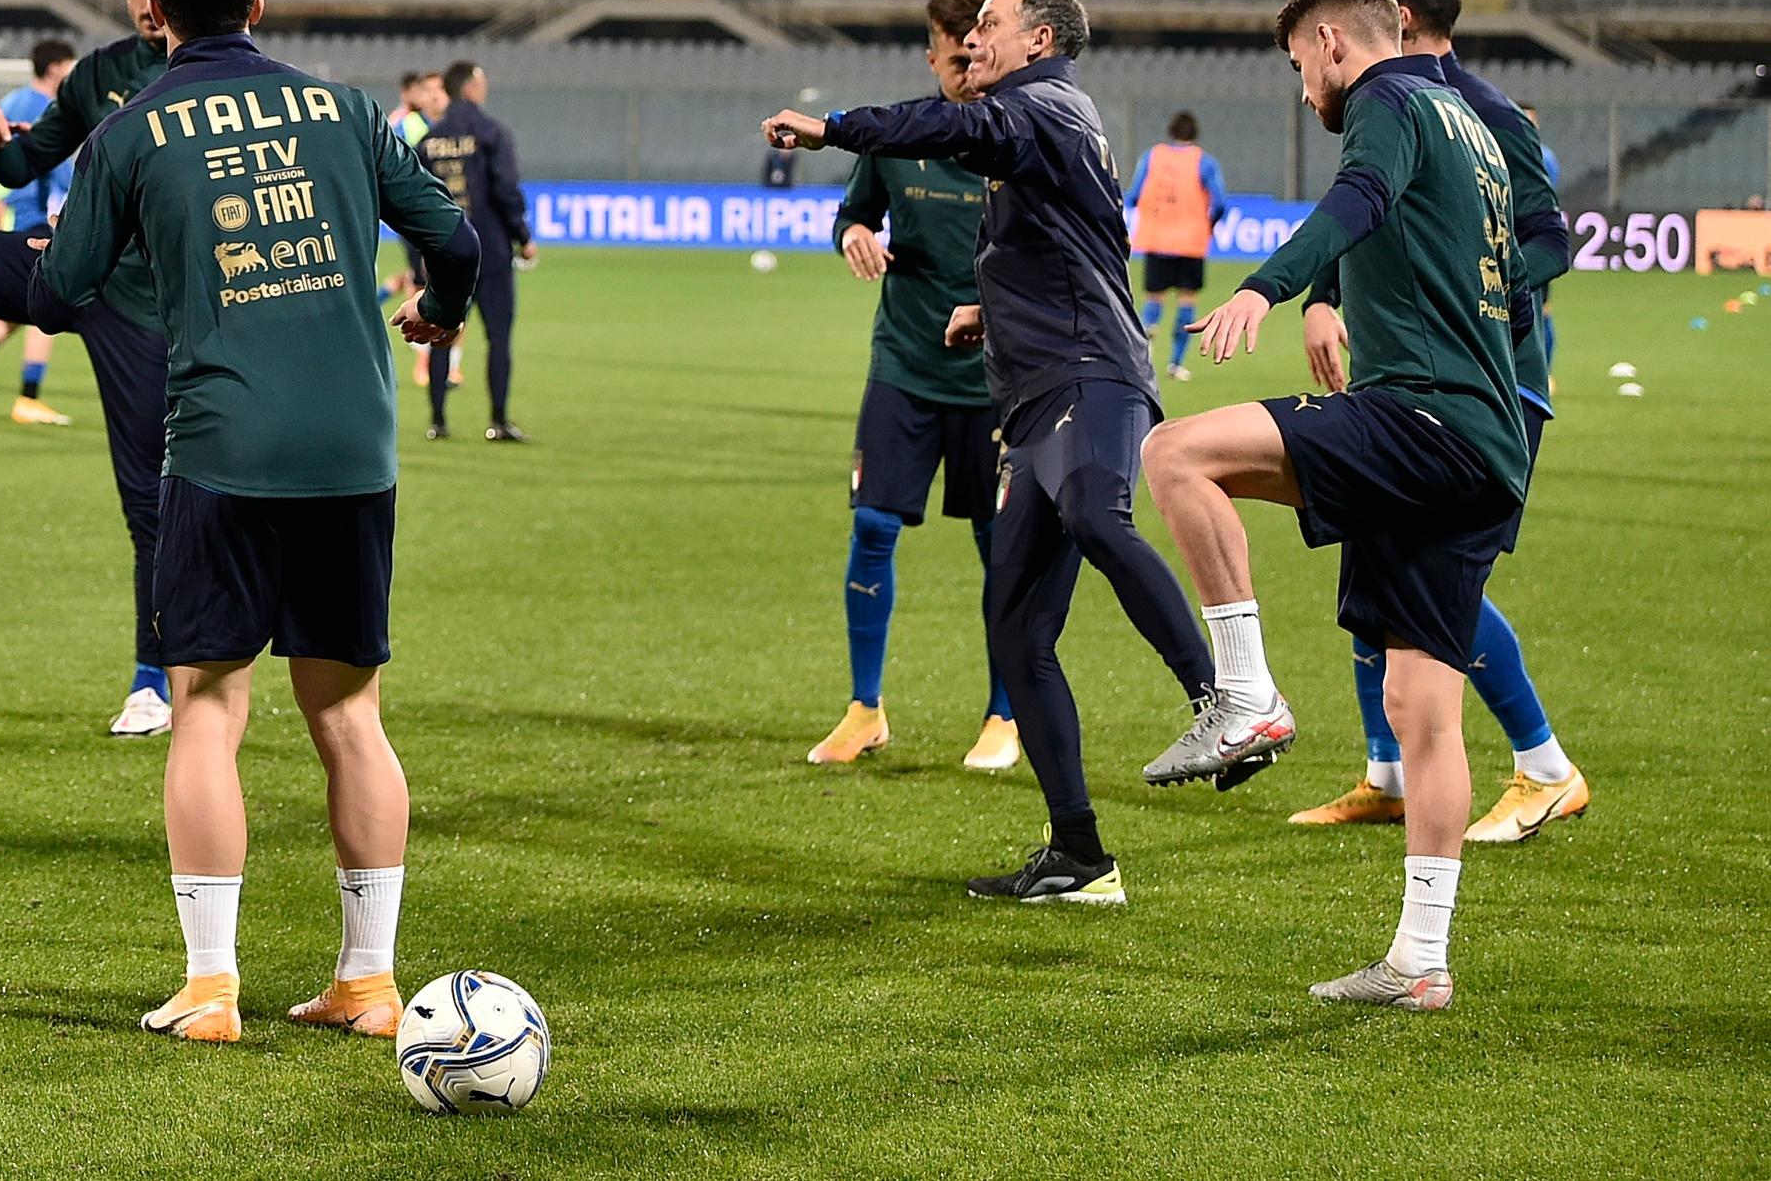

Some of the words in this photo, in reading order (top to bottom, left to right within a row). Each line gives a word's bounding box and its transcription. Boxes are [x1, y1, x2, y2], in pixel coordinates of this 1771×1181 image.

[146, 86, 341, 147] ITALIA
[246, 136, 298, 171] TV
[253, 169, 306, 185] TIMVISION
[220, 204, 242, 223] FIAT
[253, 181, 314, 226] FIAT
[535, 194, 712, 241] L'ITALIA
[271, 221, 337, 269] eni
[219, 272, 345, 308] Posteitaliane
